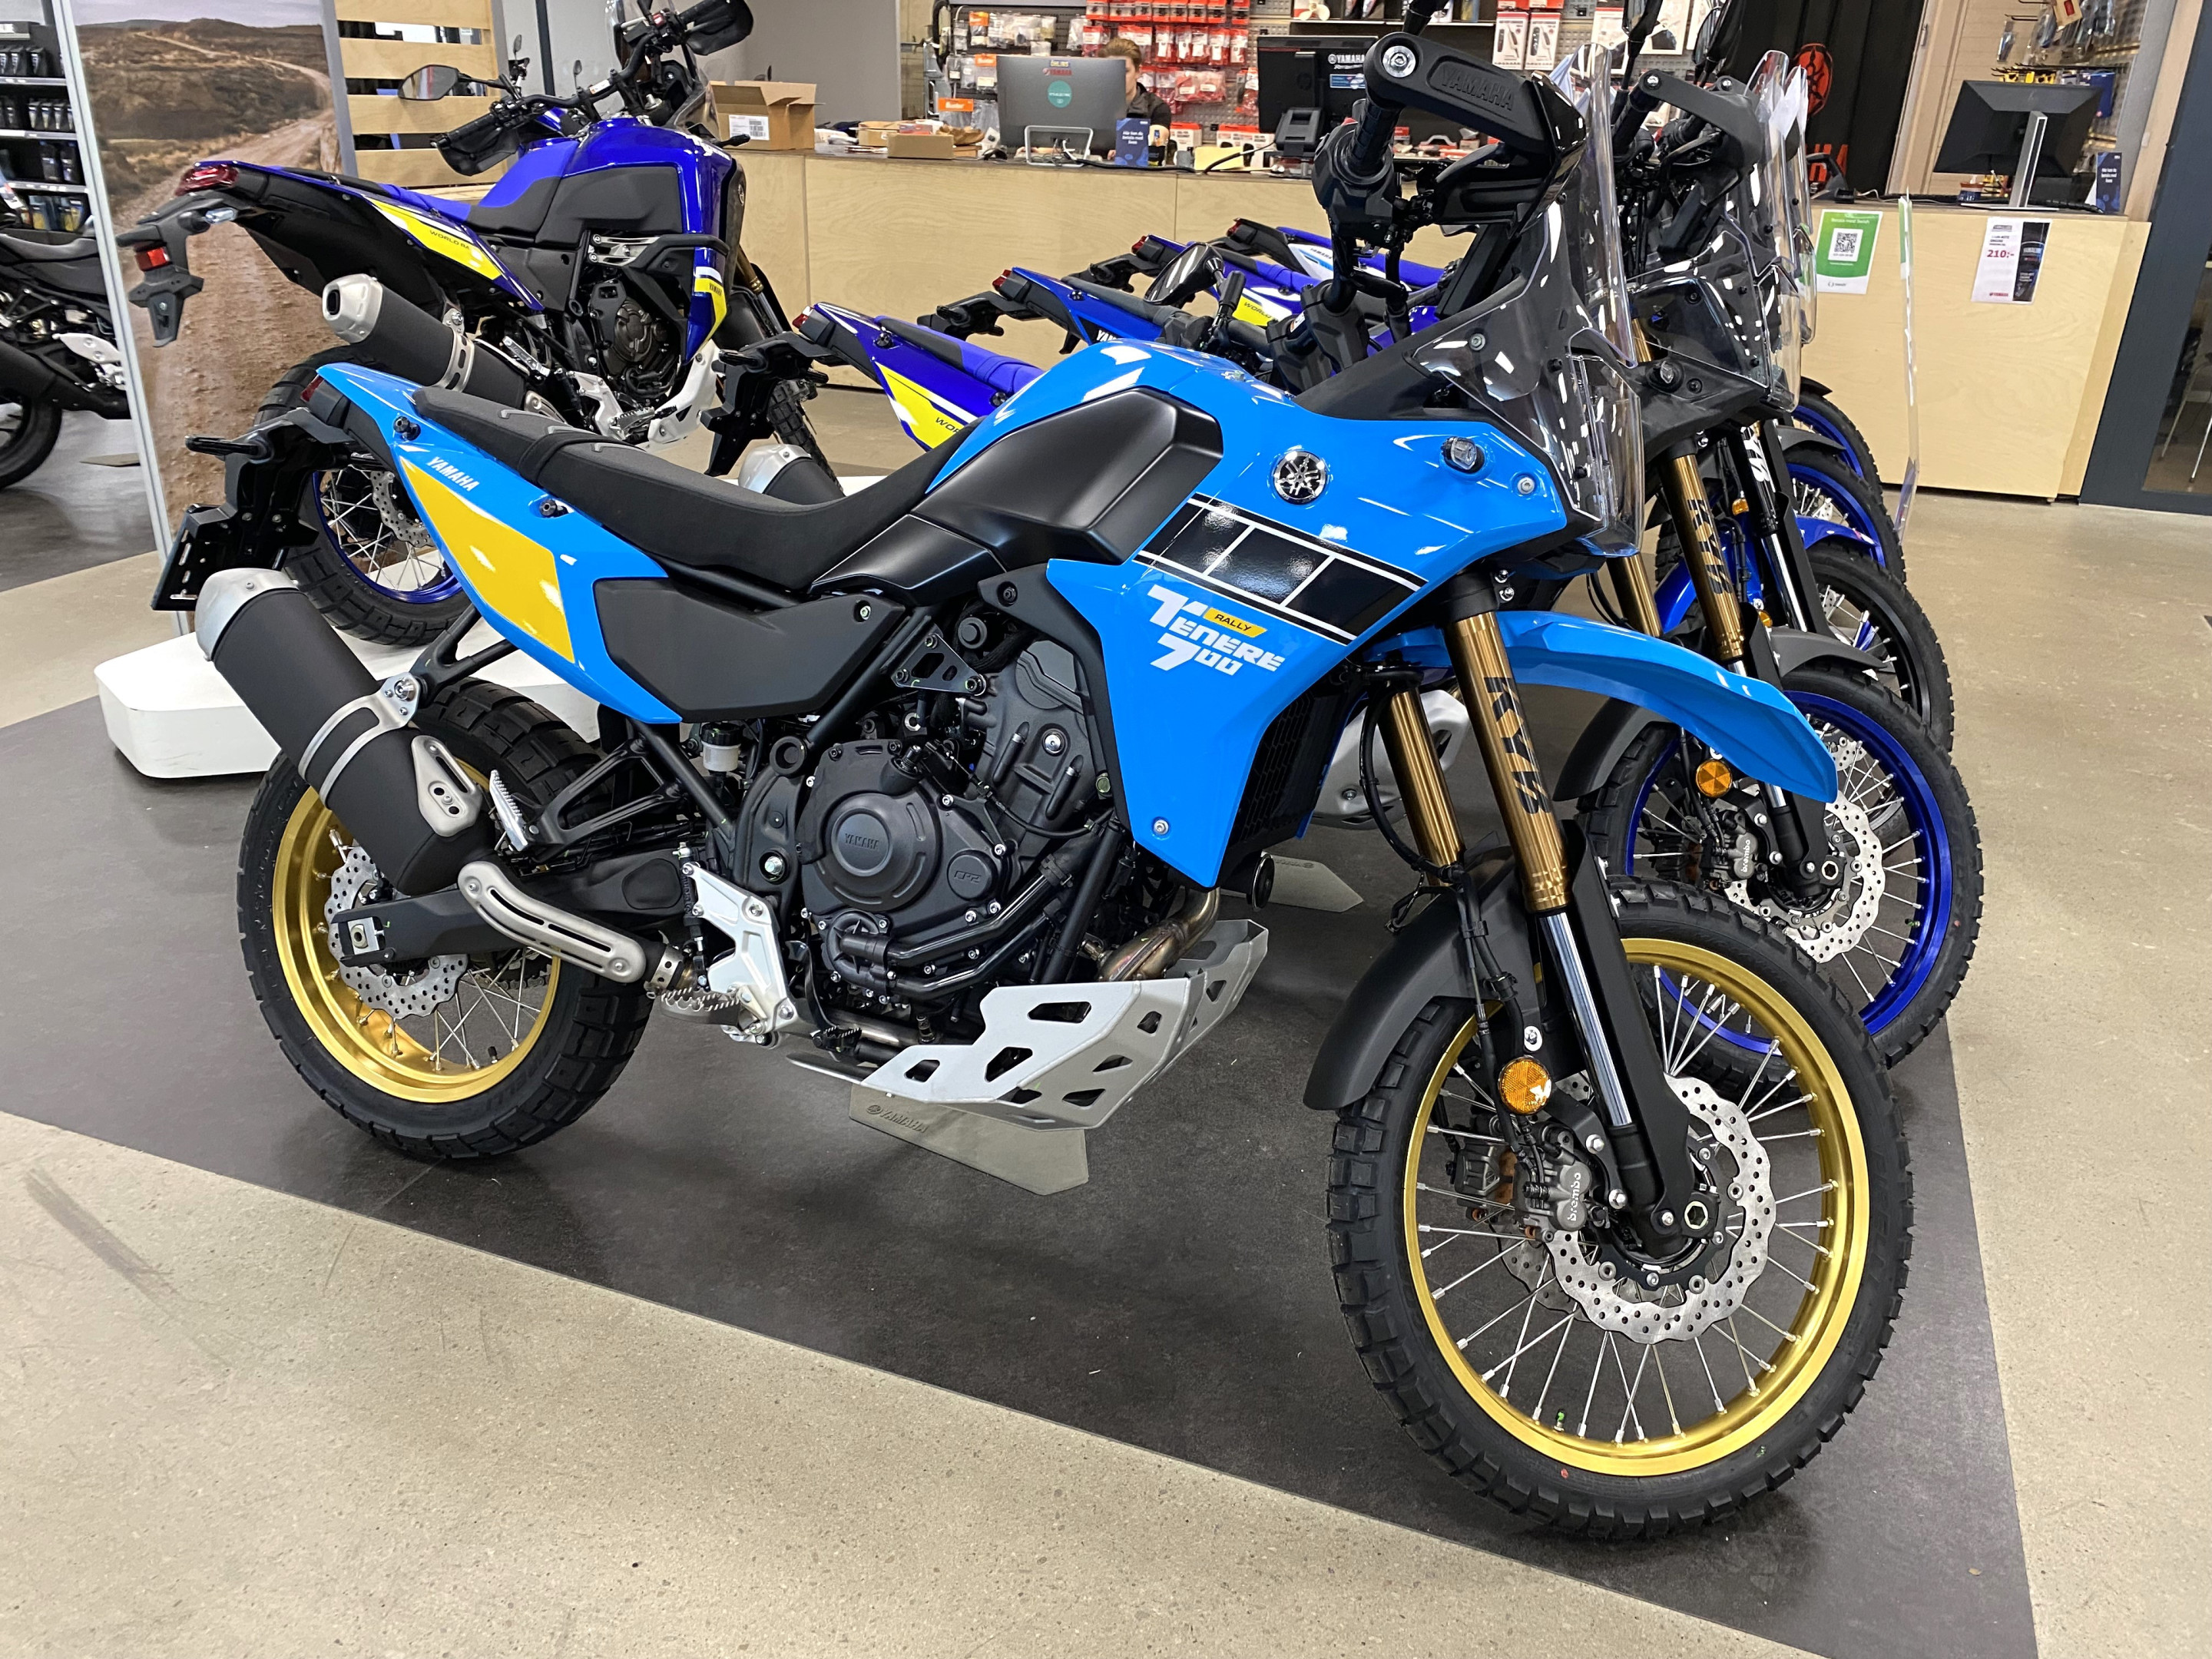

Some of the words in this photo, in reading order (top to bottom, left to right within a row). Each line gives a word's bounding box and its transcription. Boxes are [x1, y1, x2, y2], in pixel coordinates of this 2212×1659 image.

[1336, 55, 1365, 63] YAMAHA
[1440, 67, 1514, 111] YAMAHA
[430, 230, 459, 246] WORLD
[1986, 250, 2015, 258] 210:-
[1243, 302, 1273, 319] WORLD
[1096, 329, 1118, 342] YAM
[426, 456, 480, 492] YAMAHA
[1687, 499, 1734, 594] KYB
[1214, 614, 1252, 631] RALLY
[1150, 632, 1243, 676] 700
[1483, 677, 1552, 815] KYB
[845, 833, 880, 850] YAMAHA
[1740, 839, 1750, 873] brembo
[879, 1109, 929, 1134] YAMAHA
[1567, 1172, 1581, 1221] brembo
